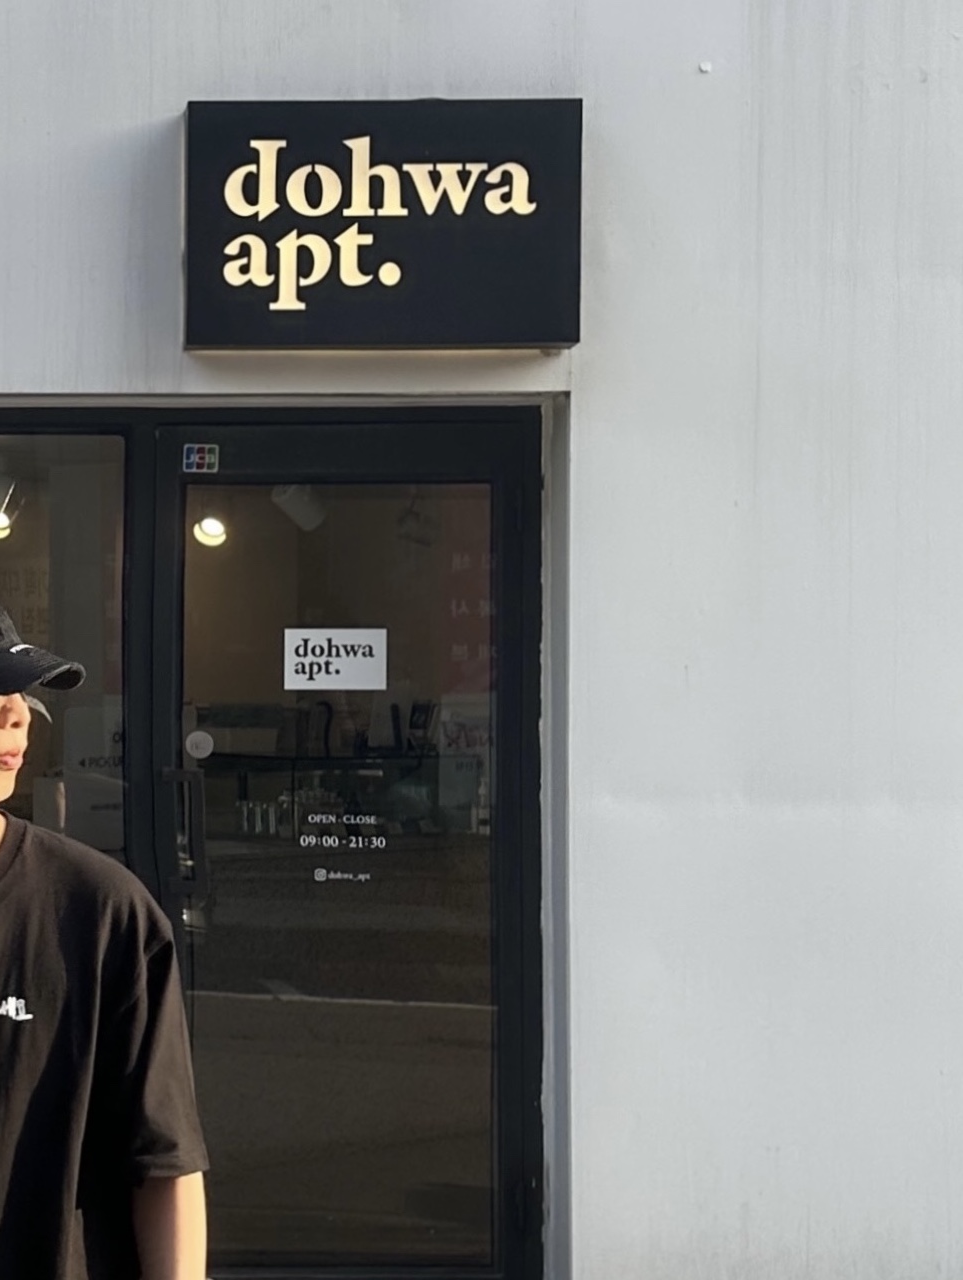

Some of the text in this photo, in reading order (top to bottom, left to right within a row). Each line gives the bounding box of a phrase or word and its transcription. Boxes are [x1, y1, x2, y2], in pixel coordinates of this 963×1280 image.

[223, 135, 536, 222] dohwa
[222, 222, 402, 310] apt.
[294, 638, 375, 659] dohwa
[294, 658, 341, 681] apt.
[308, 814, 336, 824] OPEN
[343, 814, 377, 825] CLOSE
[300, 835, 339, 847] 09:00
[349, 836, 386, 849] 21:30
